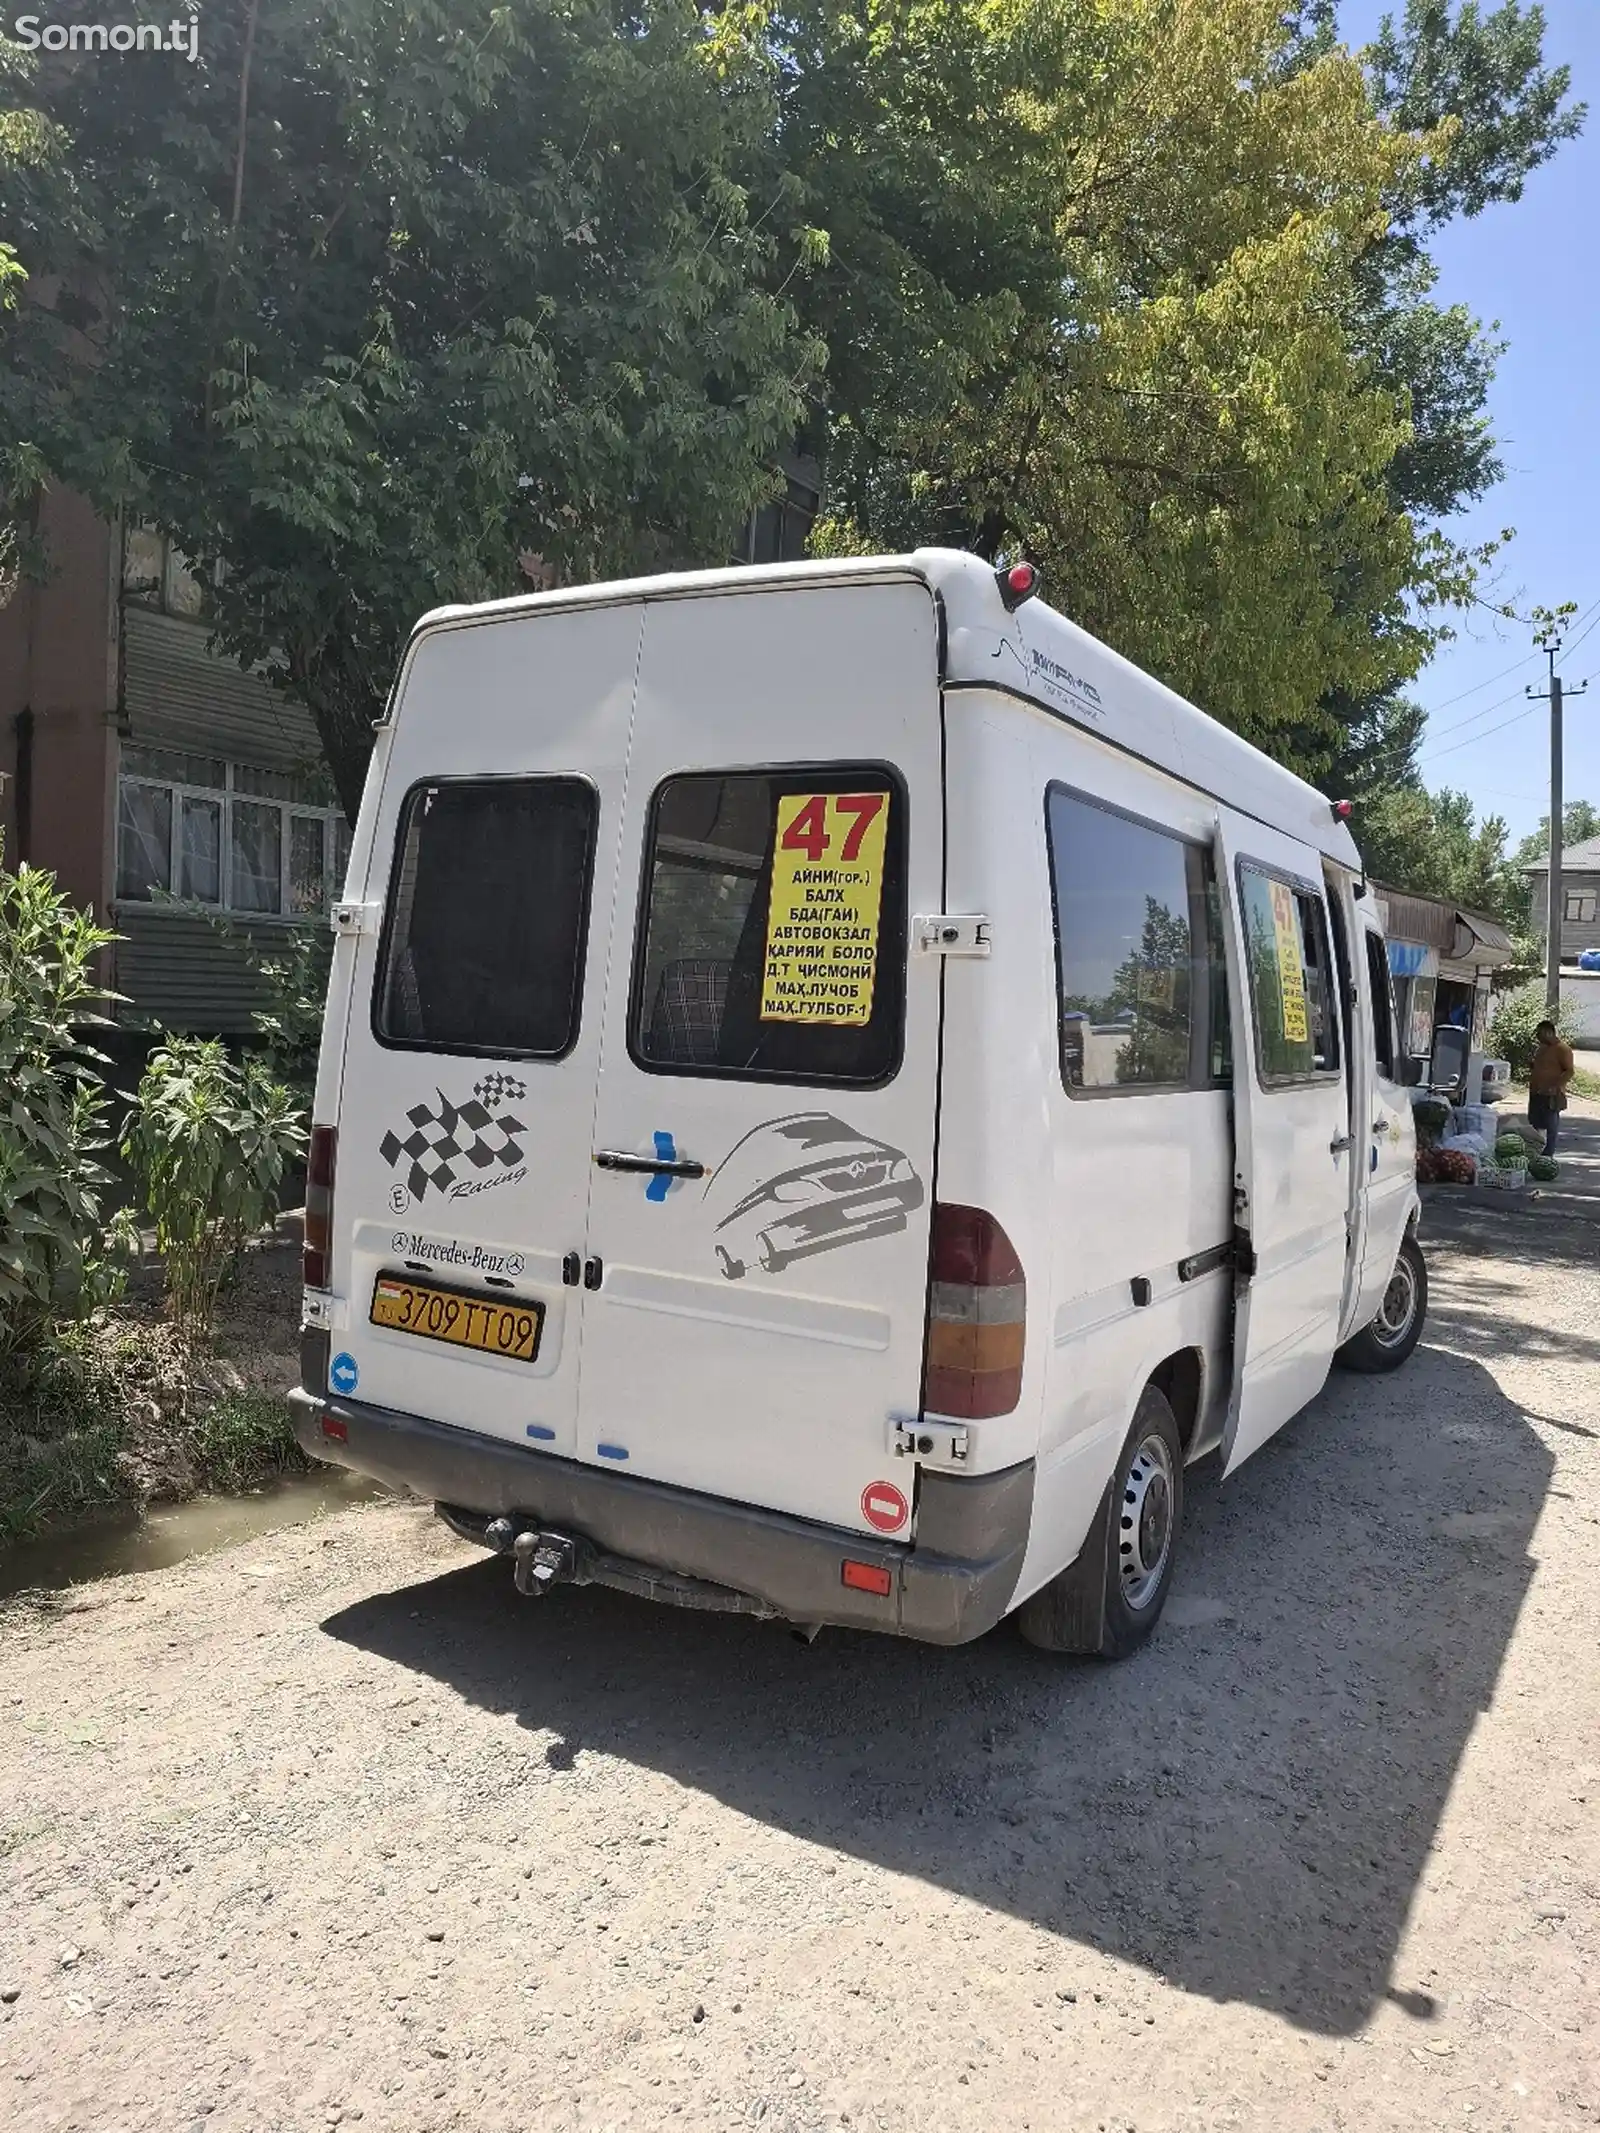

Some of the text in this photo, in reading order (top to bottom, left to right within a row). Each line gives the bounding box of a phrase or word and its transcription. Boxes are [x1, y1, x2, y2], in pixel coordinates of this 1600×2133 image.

[781, 795, 884, 862] 47
[806, 889, 844, 903] БАЛХ
[790, 908, 858, 924] БДА(ГАИ)
[774, 926, 870, 940] АВТОВОКЗАЛ
[832, 946, 874, 960] БОЛО
[449, 1166, 529, 1204] Racing
[409, 1235, 504, 1273] Mercedes-Benz
